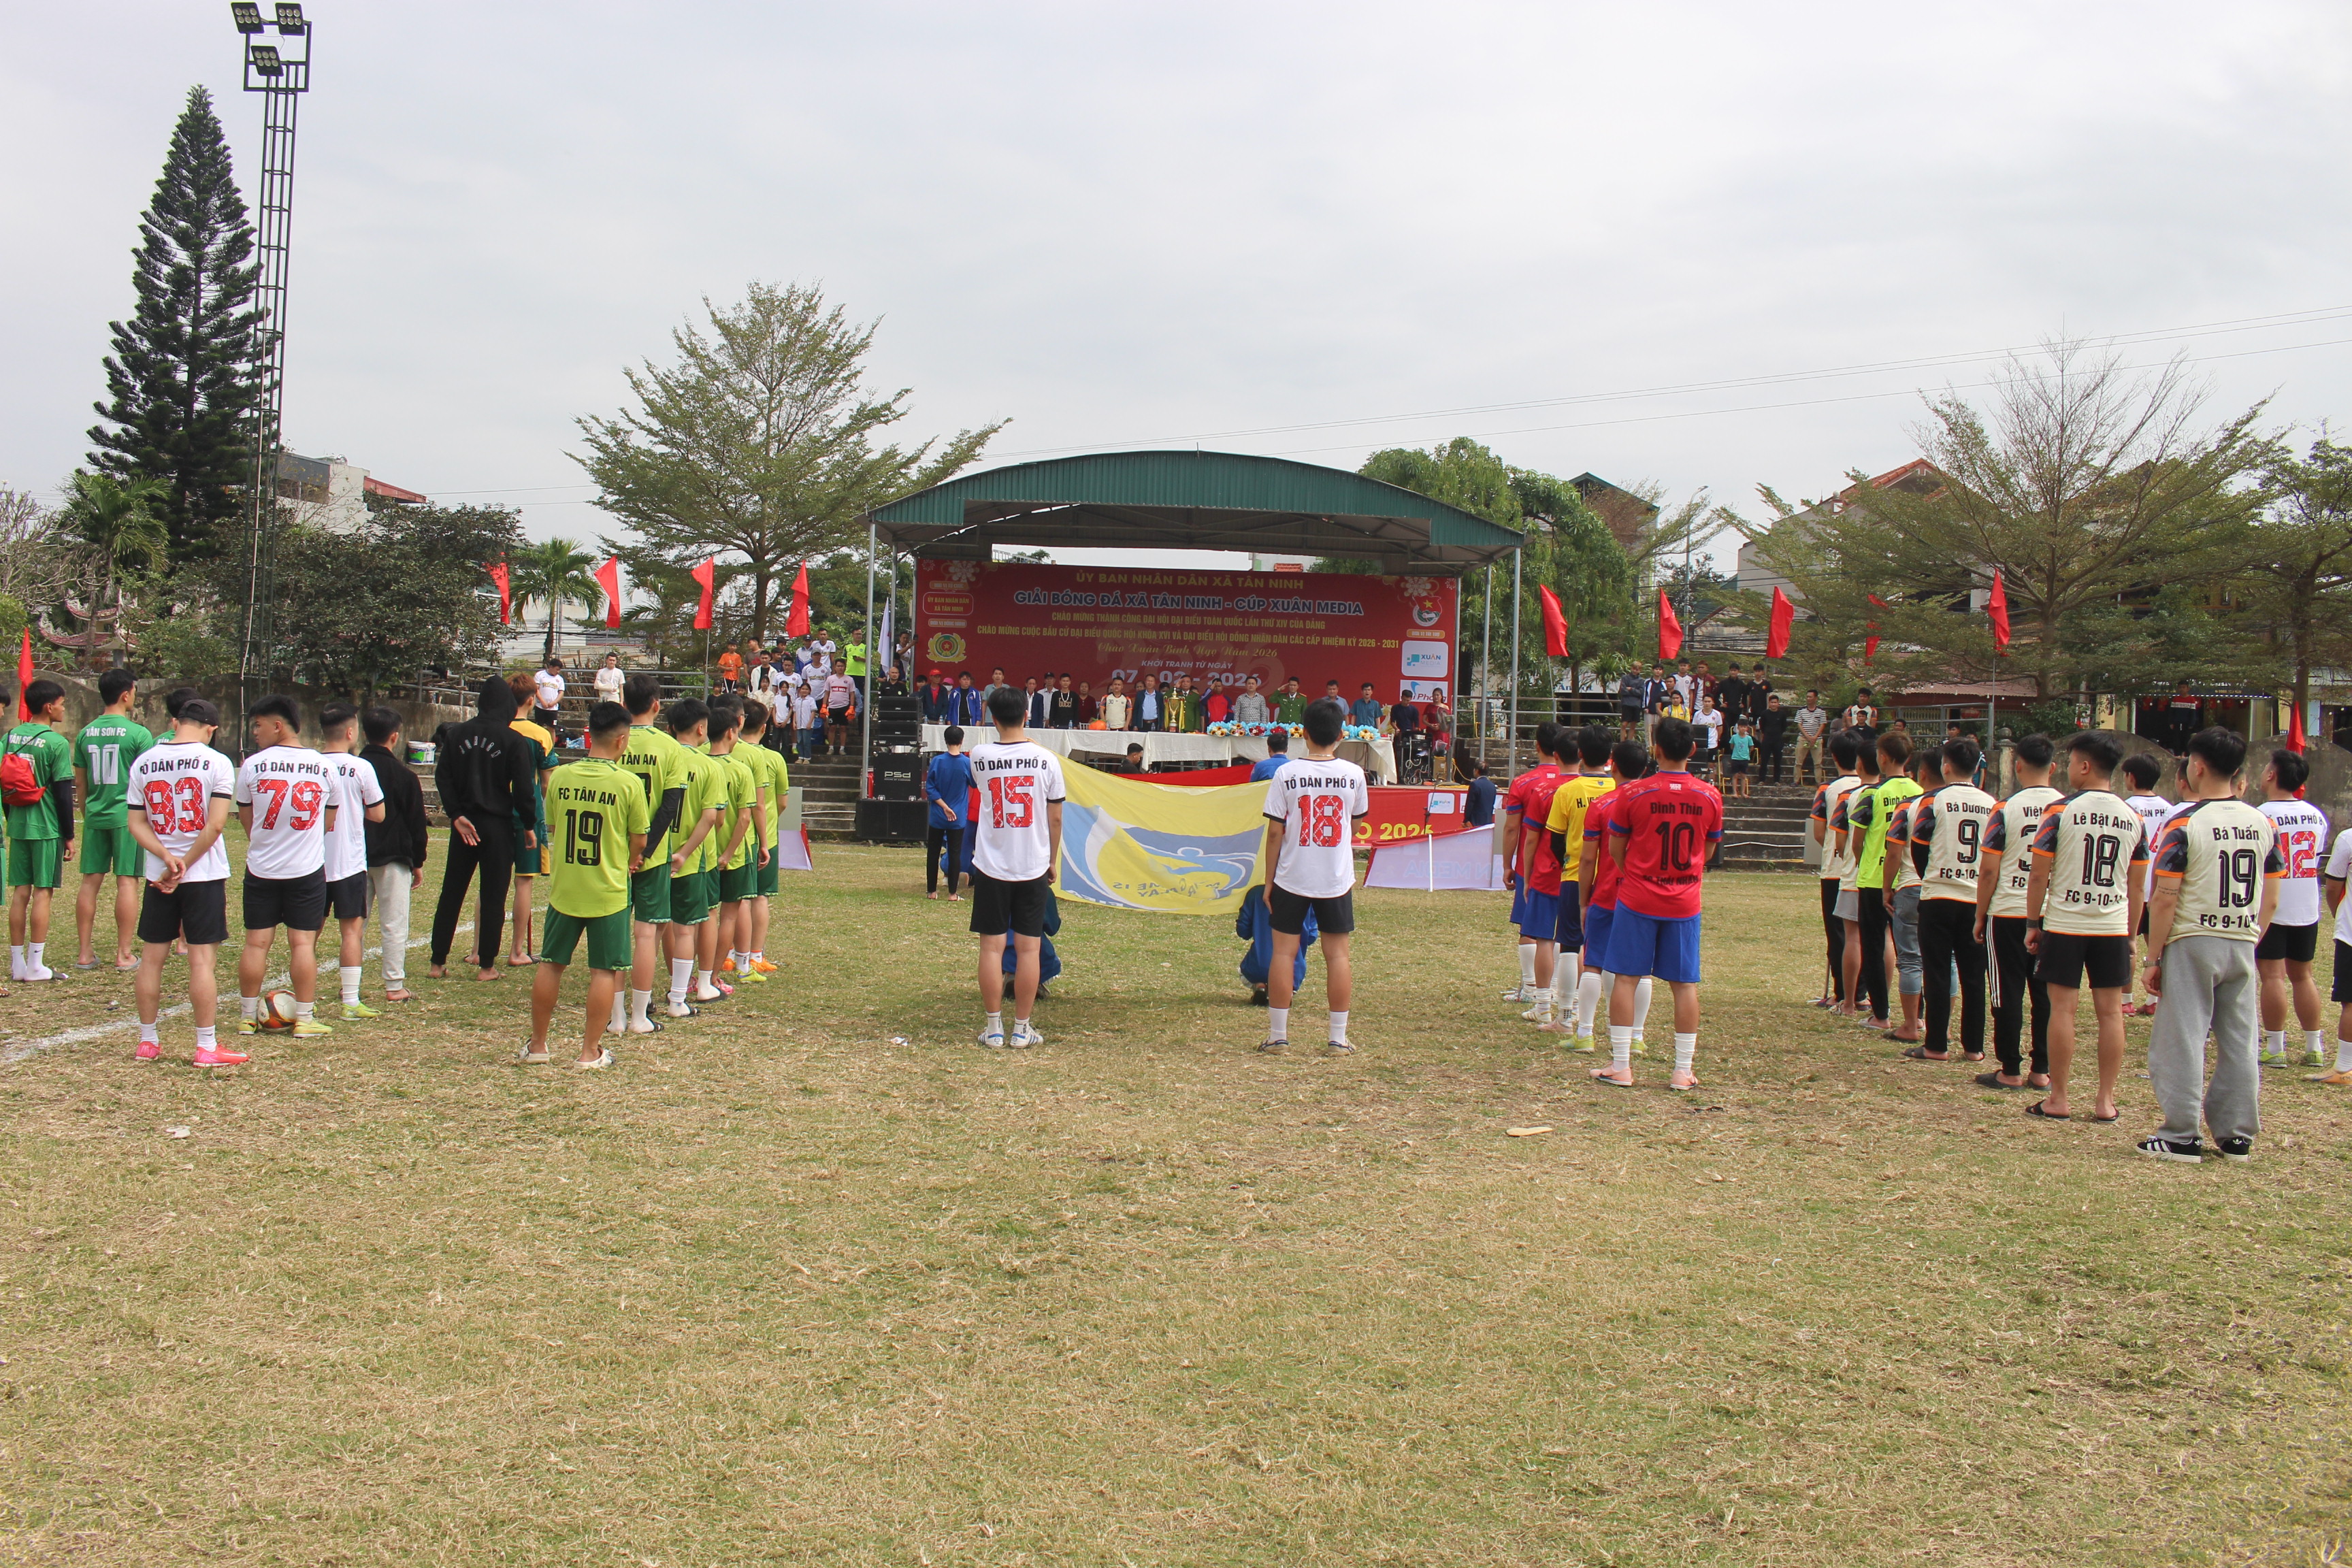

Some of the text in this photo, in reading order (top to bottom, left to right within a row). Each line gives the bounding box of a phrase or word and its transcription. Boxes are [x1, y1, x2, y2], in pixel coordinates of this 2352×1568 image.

[1077, 569, 1303, 589] ỦY BAN NHÂN DÂN XÃ TÂN NINH
[1015, 587, 1047, 604] GIẢI
[1051, 589, 1096, 606] BÓNG
[1099, 590, 1122, 606] ĐÁ
[1125, 592, 1149, 608] XÃ
[1151, 591, 1181, 608] TÂN
[1185, 595, 1222, 610] NINH
[1234, 595, 1267, 611] CÚP
[1269, 596, 1313, 613] XUÂN
[1316, 600, 1364, 615] MEDIA
[1051, 611, 1071, 621] CHÀO
[1073, 611, 1094, 621] MỪNG
[1096, 612, 1120, 622] THÀNH
[1122, 613, 1141, 623] CÔNG
[1143, 615, 1155, 625] ĐẠI
[1157, 614, 1169, 625] HỘI
[1171, 616, 1183, 626] ĐẠI
[1185, 613, 1201, 625] BIỂU
[1203, 615, 1222, 625] TOÀN
[1224, 615, 1243, 626] QUỐC
[1261, 618, 1275, 627] THỨ
[1276, 619, 1288, 627] XIV
[1290, 617, 1303, 628] CỦA
[1305, 618, 1326, 630] ĐẢNG
[977, 624, 996, 634] CHÀO
[998, 624, 1019, 635] MỪNG
[1022, 625, 1040, 637] CUỘC
[1043, 625, 1057, 636] BẦU
[1059, 625, 1069, 636] CỬ
[1071, 628, 1083, 638] ĐẠI
[1084, 625, 1100, 637] BIỂU
[1102, 627, 1122, 638] QUỐC
[1124, 628, 1135, 640] HỘI
[1138, 630, 1156, 639] KHÓA
[1159, 631, 1170, 640] XVI
[1172, 630, 1181, 640] VÀ
[1183, 632, 1195, 642] ĐẠI
[1197, 630, 1213, 640] BIỂU
[1215, 632, 1227, 642] HỘI
[1230, 632, 1249, 642] ĐỒNG
[1251, 633, 1271, 643] NHÂN
[1273, 633, 1288, 644] DÂN
[1290, 634, 1305, 644] CÁC
[1306, 634, 1320, 645] CẤP
[1322, 636, 1345, 647] NHIỆM
[1348, 636, 1356, 647] KỲ
[1358, 638, 1375, 647] 2026
[1382, 640, 1399, 648] 2031
[1252, 649, 1277, 657] 2026
[1141, 658, 1163, 667] KHỞI
[1208, 661, 1232, 669] NGÀY
[1111, 669, 1138, 683] 07
[1418, 693, 1447, 702] Phog
[116, 728, 127, 736] FC
[35, 738, 46, 748] FC
[151, 759, 174, 773] DÂN
[178, 755, 201, 770] PHỐ
[203, 760, 210, 770] 8
[255, 758, 267, 774] TỔ
[271, 760, 293, 773] DÂN
[298, 762, 321, 774] PHỐ
[621, 752, 657, 766] TÂN AN
[974, 755, 1047, 772] TỔ DÂN PHỐ 8
[349, 768, 356, 777] 8
[1284, 774, 1355, 790] TỔ DÂN PHỐ 8
[257, 779, 323, 830] 79
[559, 787, 617, 806] FC TÂN AN
[987, 776, 1034, 828] 15
[144, 777, 205, 835] 93
[1946, 802, 1959, 813] Bá
[2023, 806, 2042, 819] Việt
[2140, 808, 2153, 817] DÂN
[1298, 795, 1343, 847] 18
[2073, 812, 2133, 832] Lê Bật Anh
[2277, 814, 2298, 826] DÂN
[2301, 813, 2317, 825] PHỐ
[566, 809, 603, 866] 19
[2212, 825, 2259, 840] Bá Tuấn
[1655, 821, 1695, 871] 10
[1957, 819, 1979, 864] 9
[2081, 833, 2120, 887] 18
[2280, 831, 2317, 879] 12
[1940, 868, 1953, 879] FC
[2012, 876, 2025, 887] FC
[2219, 849, 2256, 908] 19
[2065, 889, 2080, 903] FC
[2200, 914, 2217, 928] FC
